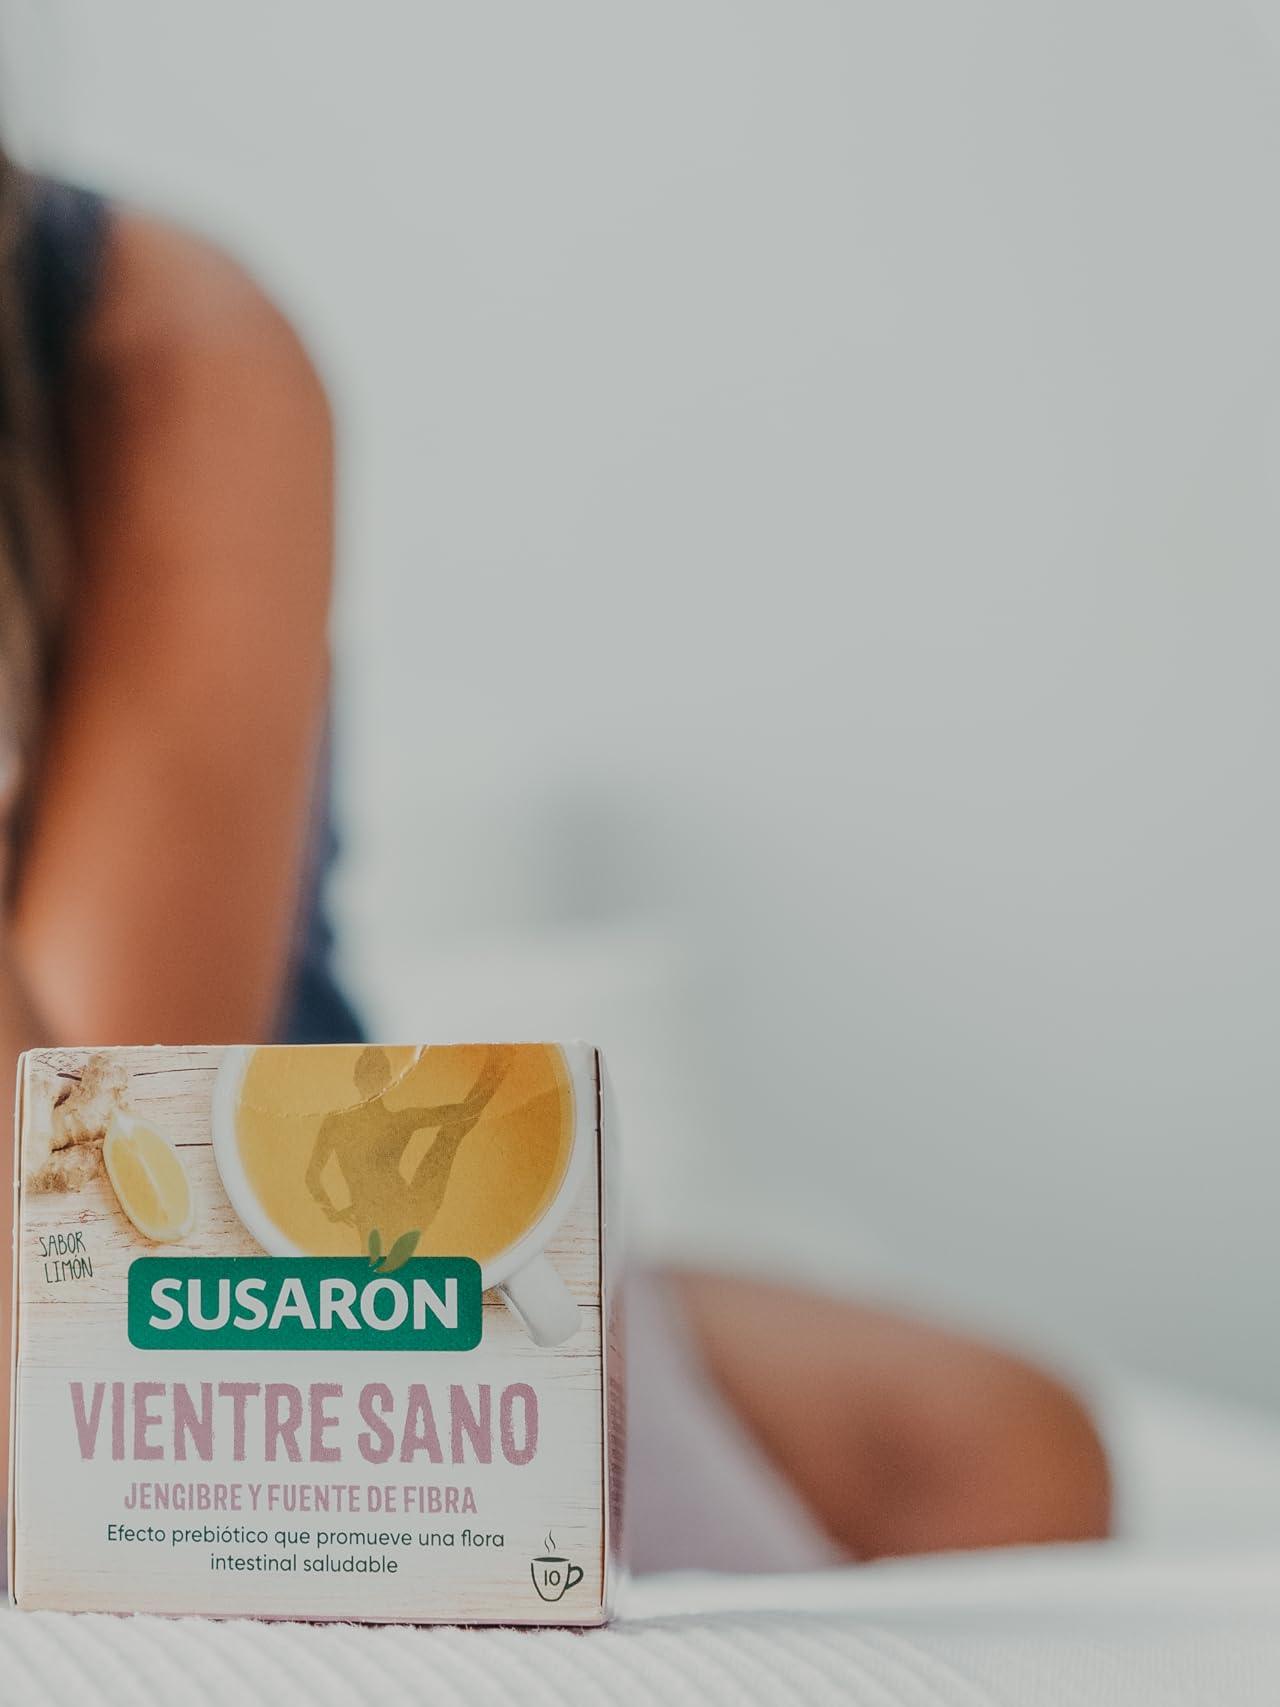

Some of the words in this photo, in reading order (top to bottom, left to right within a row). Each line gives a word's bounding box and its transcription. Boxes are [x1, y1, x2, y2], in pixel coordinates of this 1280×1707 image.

[40, 1232, 86, 1258] SABOR
[45, 1257, 93, 1284] LIMÓN
[69, 1382, 344, 1462] VIENTRE
[358, 1382, 539, 1466] SANO
[125, 1483, 243, 1511] JENGIBRE
[247, 1484, 263, 1511] Y
[268, 1484, 361, 1513] FUENTE
[368, 1485, 397, 1513] DE
[404, 1486, 477, 1515] FIBRA
[108, 1525, 166, 1546] Efecto
[173, 1524, 267, 1548] prebiótico
[275, 1529, 311, 1551] que
[317, 1530, 412, 1551] promueve
[419, 1531, 454, 1548] una
[461, 1527, 505, 1548] flora
[210, 1554, 297, 1572] intestinal
[304, 1555, 398, 1574] saludable
[543, 1570, 561, 1587] 10
